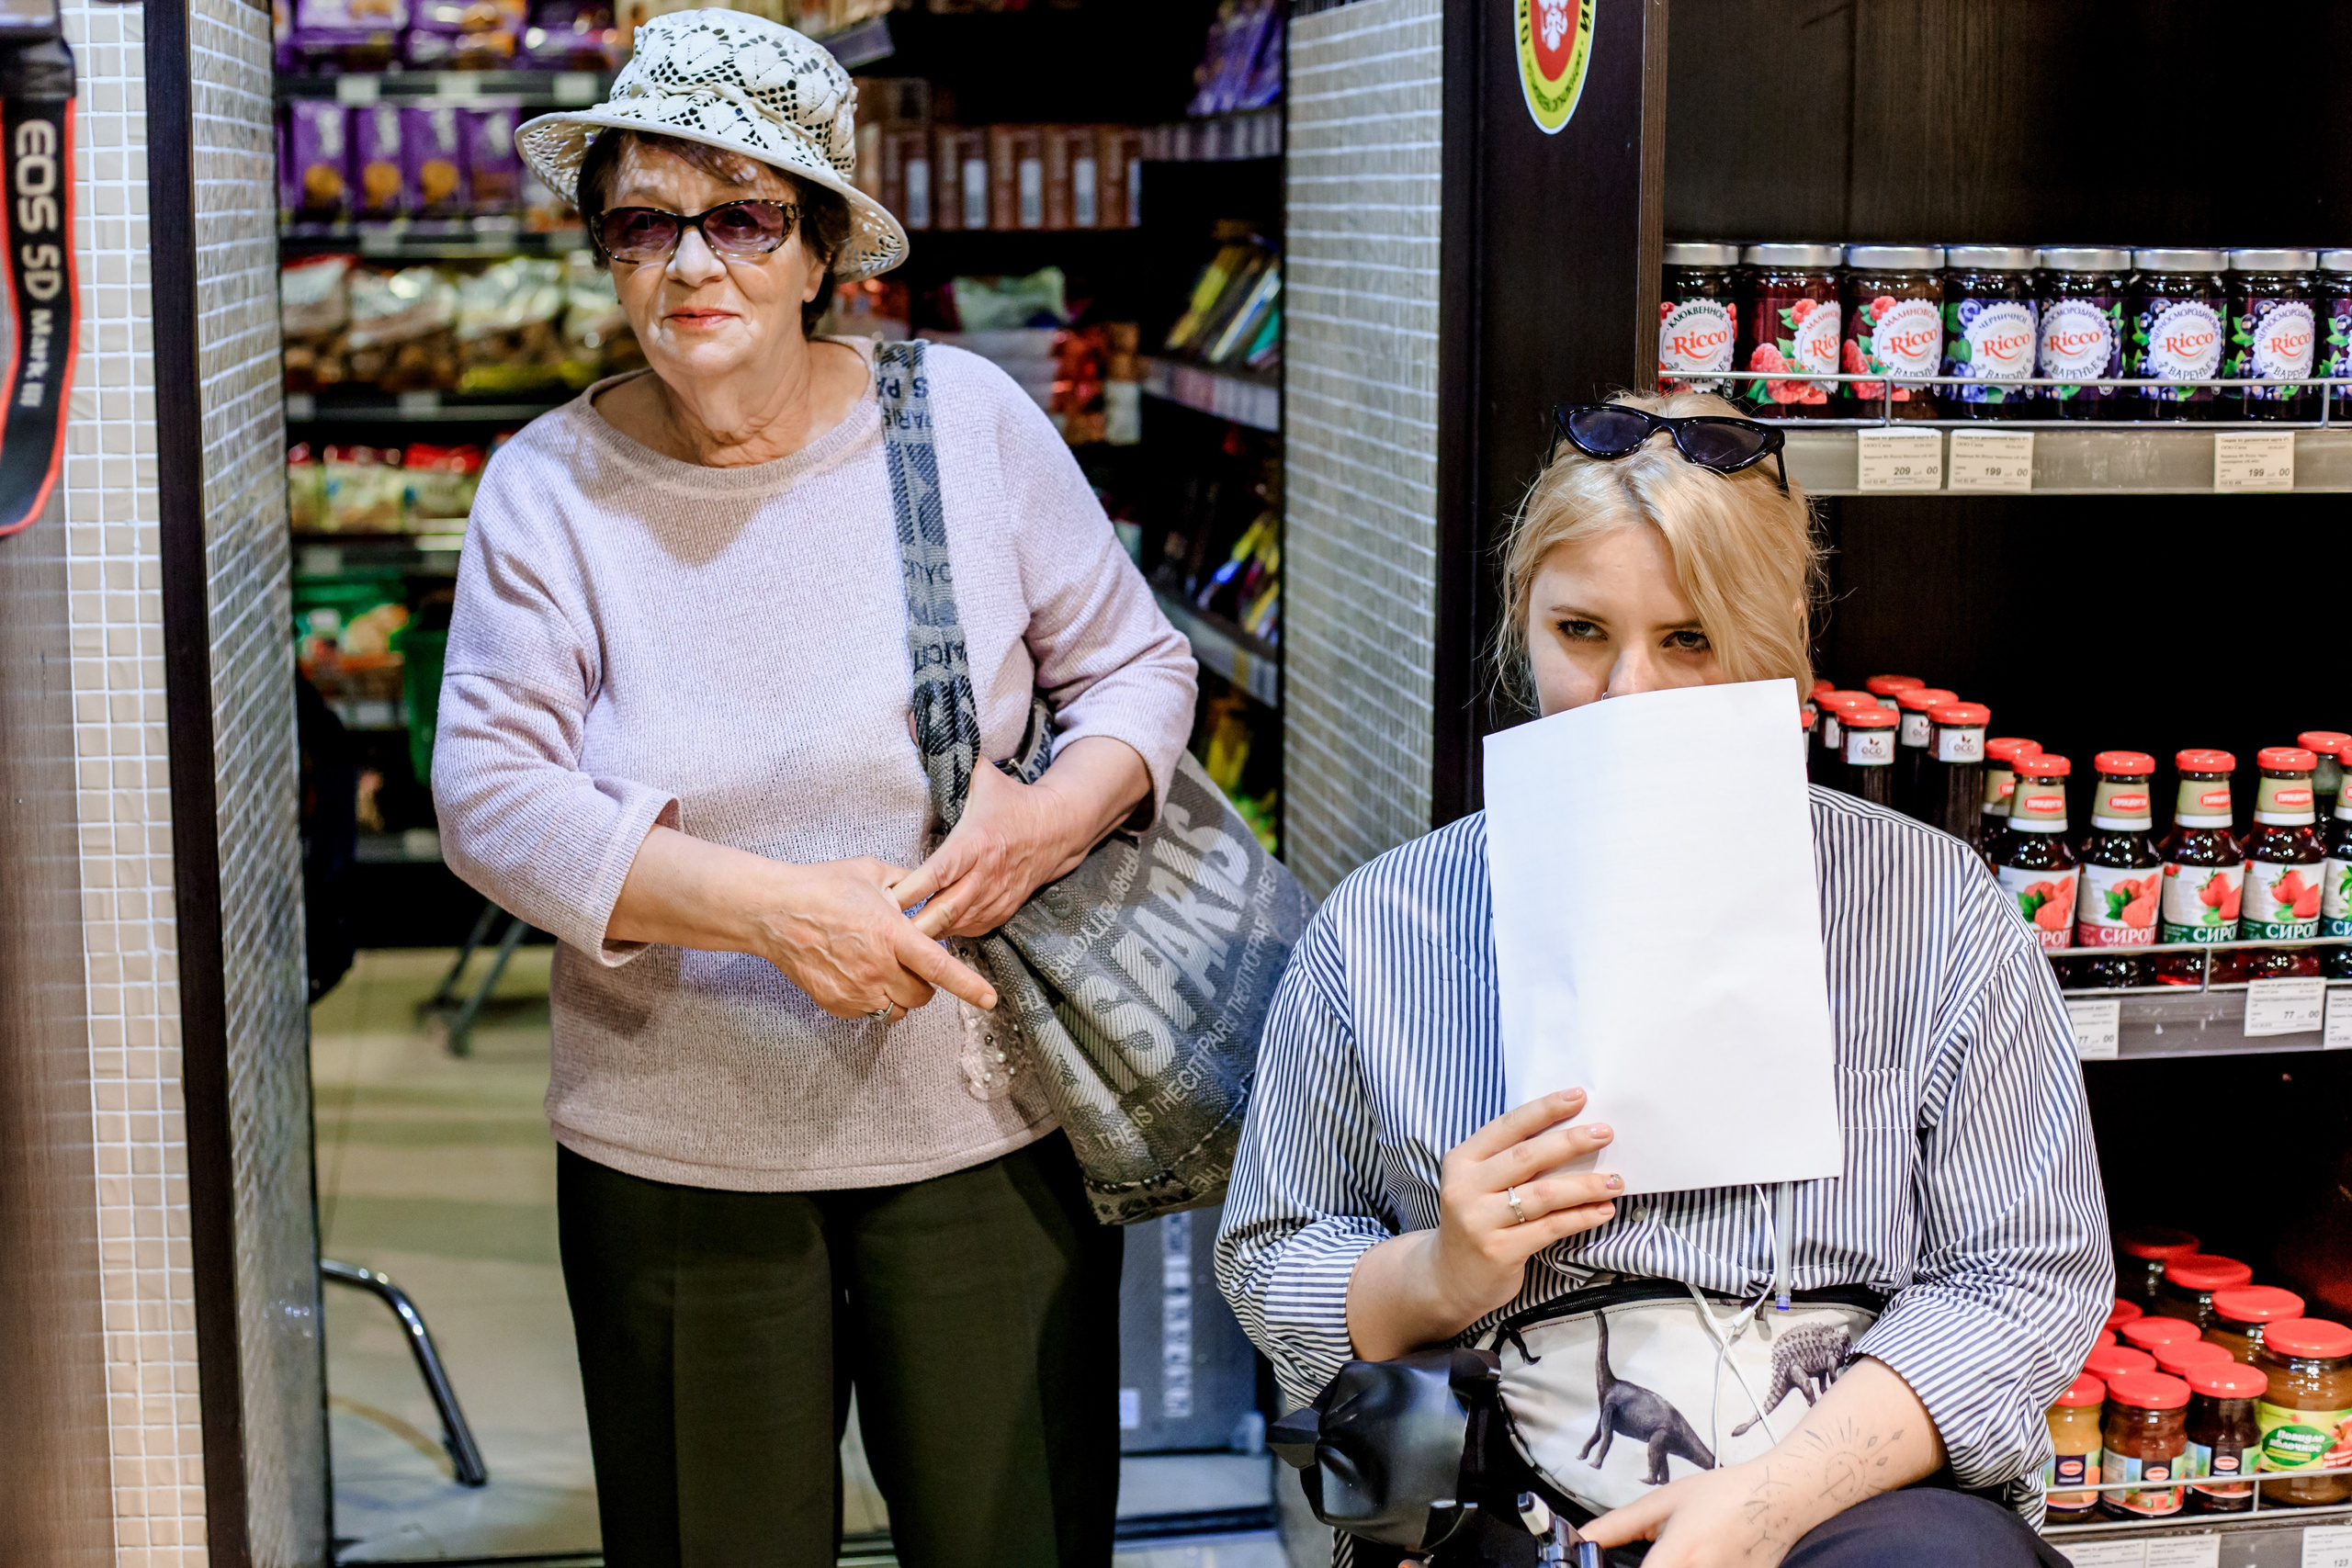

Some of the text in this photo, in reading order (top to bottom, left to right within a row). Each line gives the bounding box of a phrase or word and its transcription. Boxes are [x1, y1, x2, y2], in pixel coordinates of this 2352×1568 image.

[15, 119, 59, 232] EOS
[21, 243, 62, 300] 5D
[25, 309, 52, 378] Mark
[1673, 331, 1727, 359] Ricco
[1890, 329, 1938, 357] Ricco
[1983, 333, 2030, 359] Ricco
[2050, 332, 2100, 355] Ricco
[2165, 332, 2213, 356] Ricco
[2271, 333, 2312, 356] Ricco
[2052, 360, 2099, 378] ВАРЕНЬЕ
[2168, 361, 2212, 380] ВАРЕНЬЕ
[1893, 466, 1939, 476] 209 00
[1985, 468, 2029, 477] 199 00
[2249, 468, 2290, 477] 199 00
[2100, 927, 2156, 943] СИРОП
[2266, 921, 2319, 939] СИРОП
[2284, 1010, 2320, 1020] 77 00
[2078, 1034, 2115, 1044] 77 00
[2334, 1558, 2348, 1568] 123
